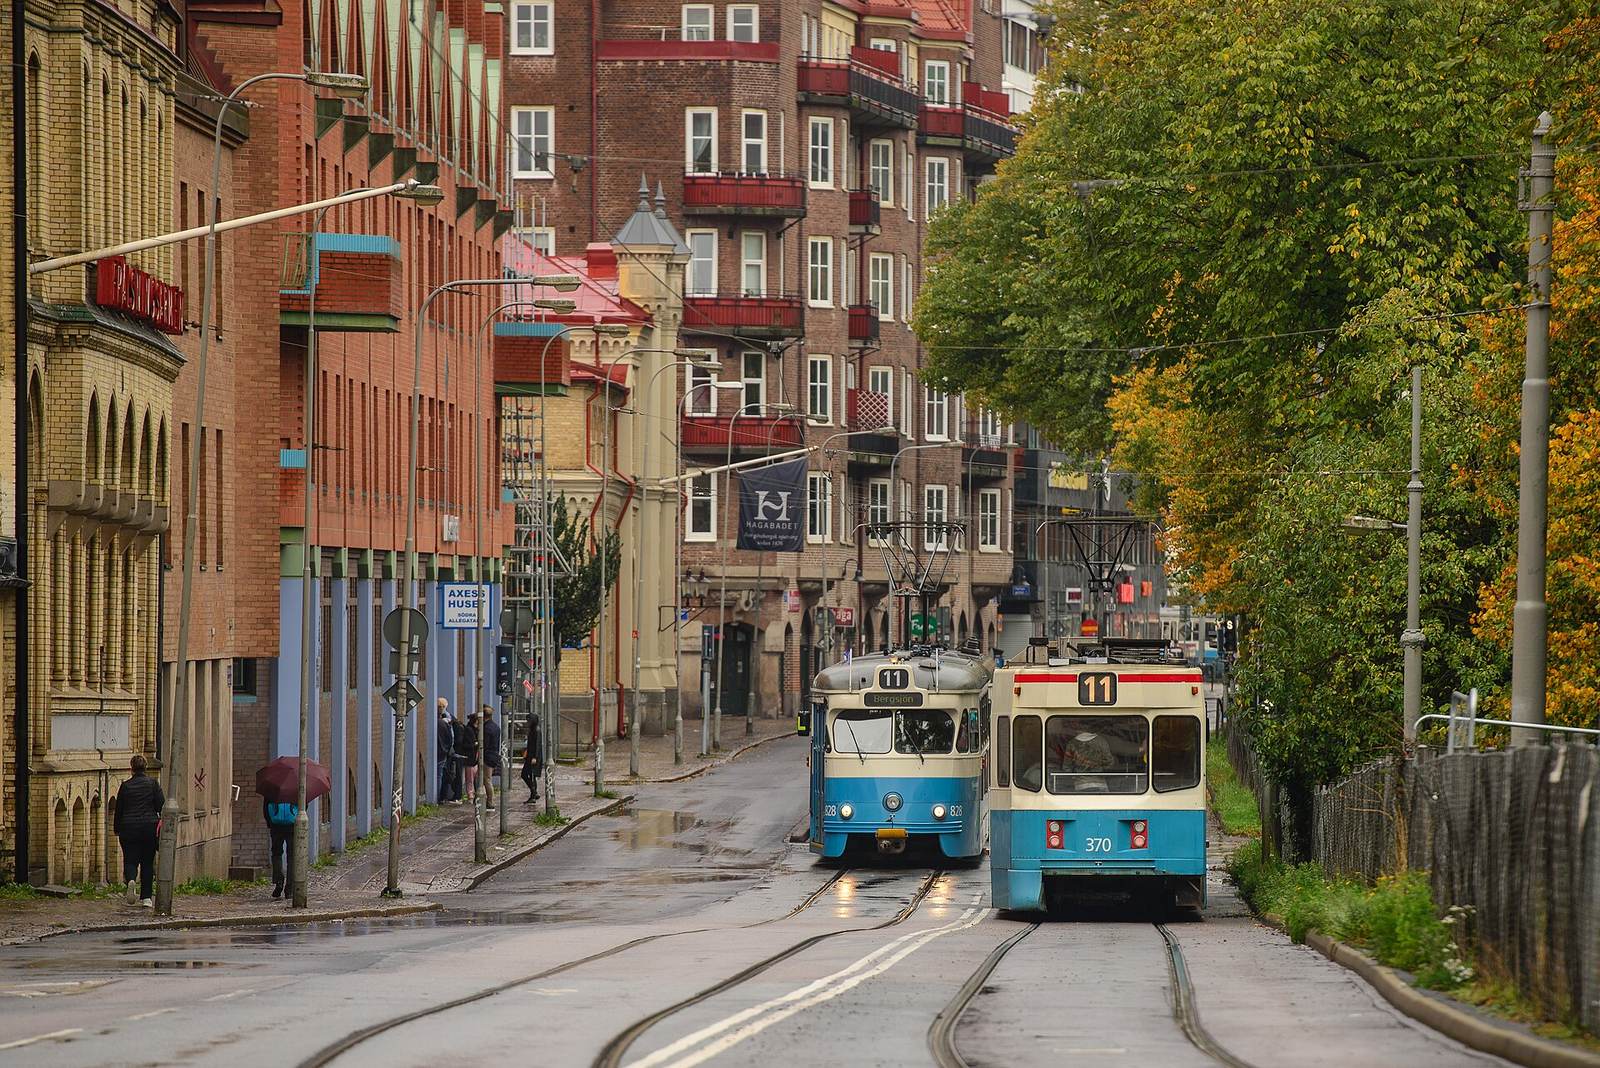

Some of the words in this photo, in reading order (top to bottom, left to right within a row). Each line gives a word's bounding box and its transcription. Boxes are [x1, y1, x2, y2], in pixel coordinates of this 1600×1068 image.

[746, 521, 798, 529] HAGABADET
[883, 670, 901, 687] 11
[1083, 675, 1111, 703] 11
[950, 805, 963, 817] 828
[1085, 837, 1112, 852] 370
